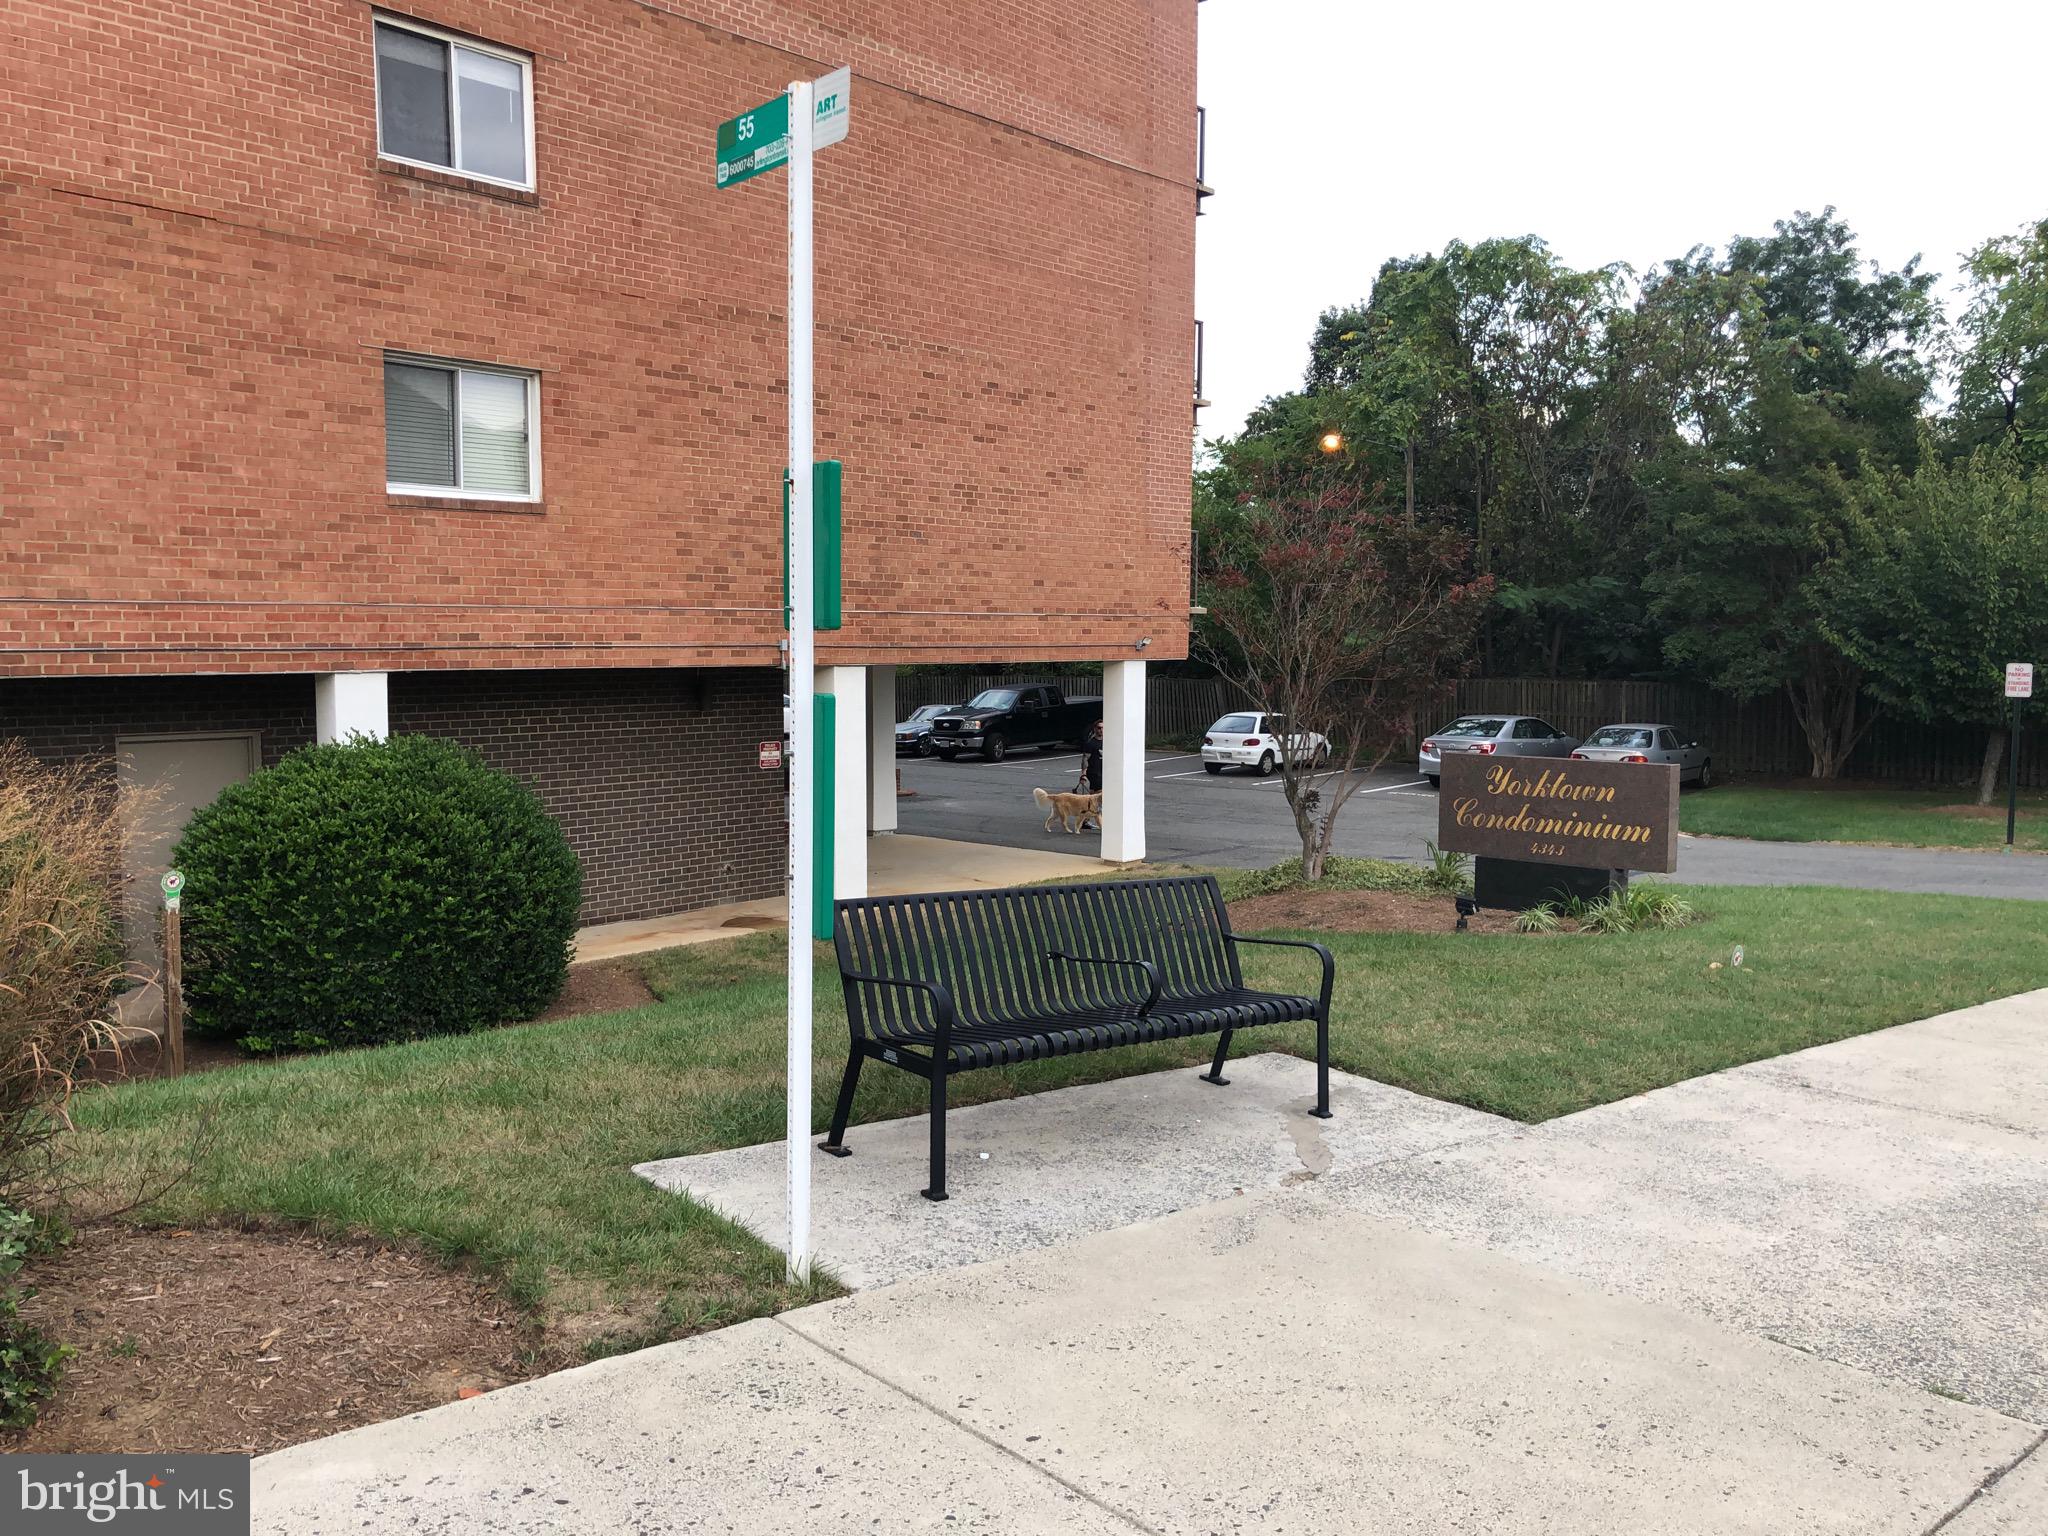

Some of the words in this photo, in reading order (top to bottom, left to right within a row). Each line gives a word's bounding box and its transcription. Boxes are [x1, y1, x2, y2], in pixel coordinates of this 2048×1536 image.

[816, 94, 837, 116] ART
[738, 115, 755, 141] 55
[1486, 765, 1616, 803] Yorktown
[1453, 797, 1651, 843] Condominium
[1530, 842, 1565, 856] 4343
